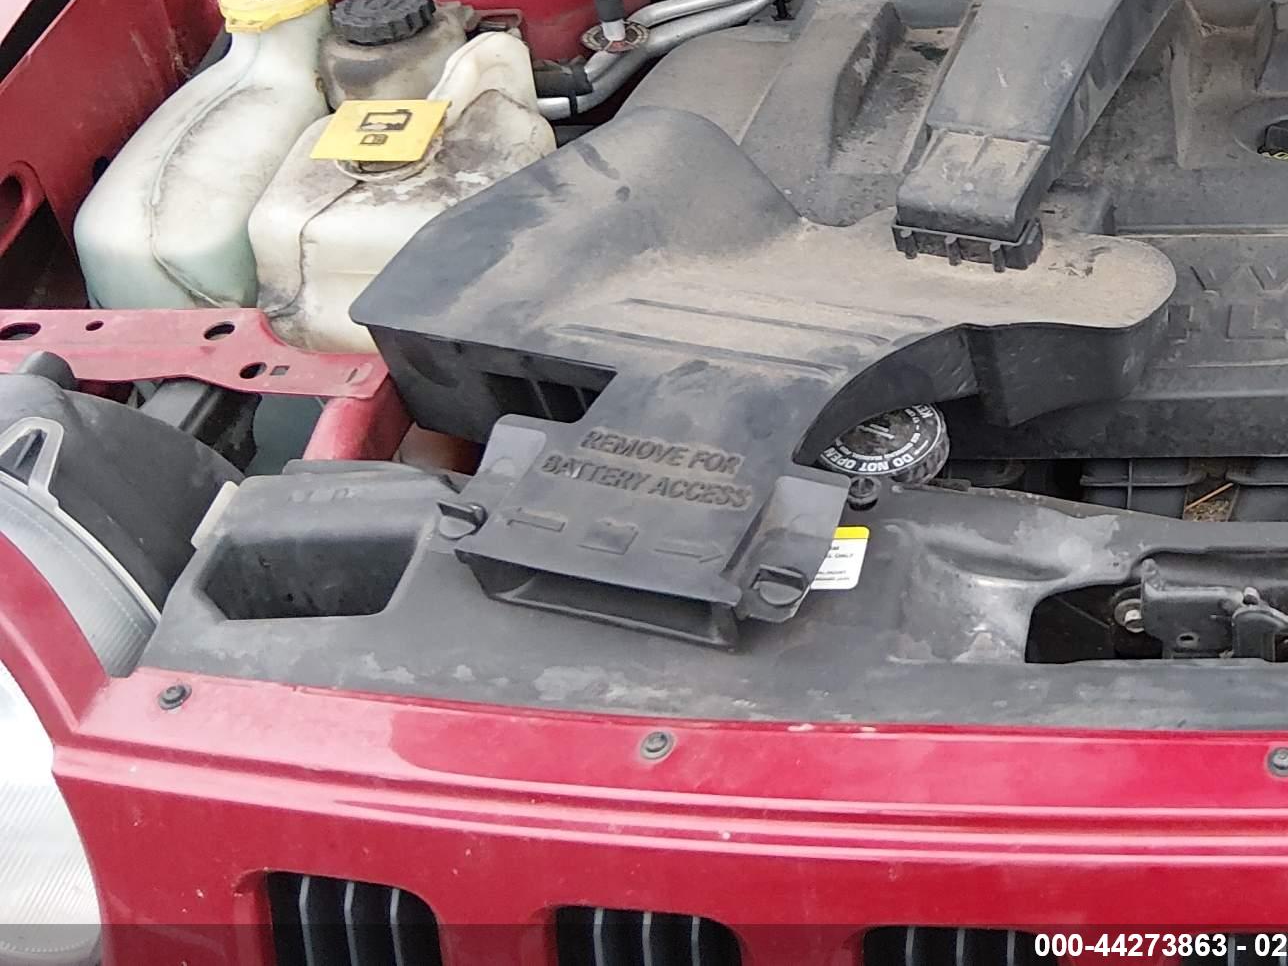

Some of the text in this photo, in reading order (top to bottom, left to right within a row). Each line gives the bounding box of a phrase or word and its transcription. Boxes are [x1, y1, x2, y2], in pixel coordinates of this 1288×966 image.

[580, 428, 745, 475] REMOVE FOR
[823, 446, 914, 472] DO NOT OPEN
[541, 453, 752, 509] BATTERY ACCESS
